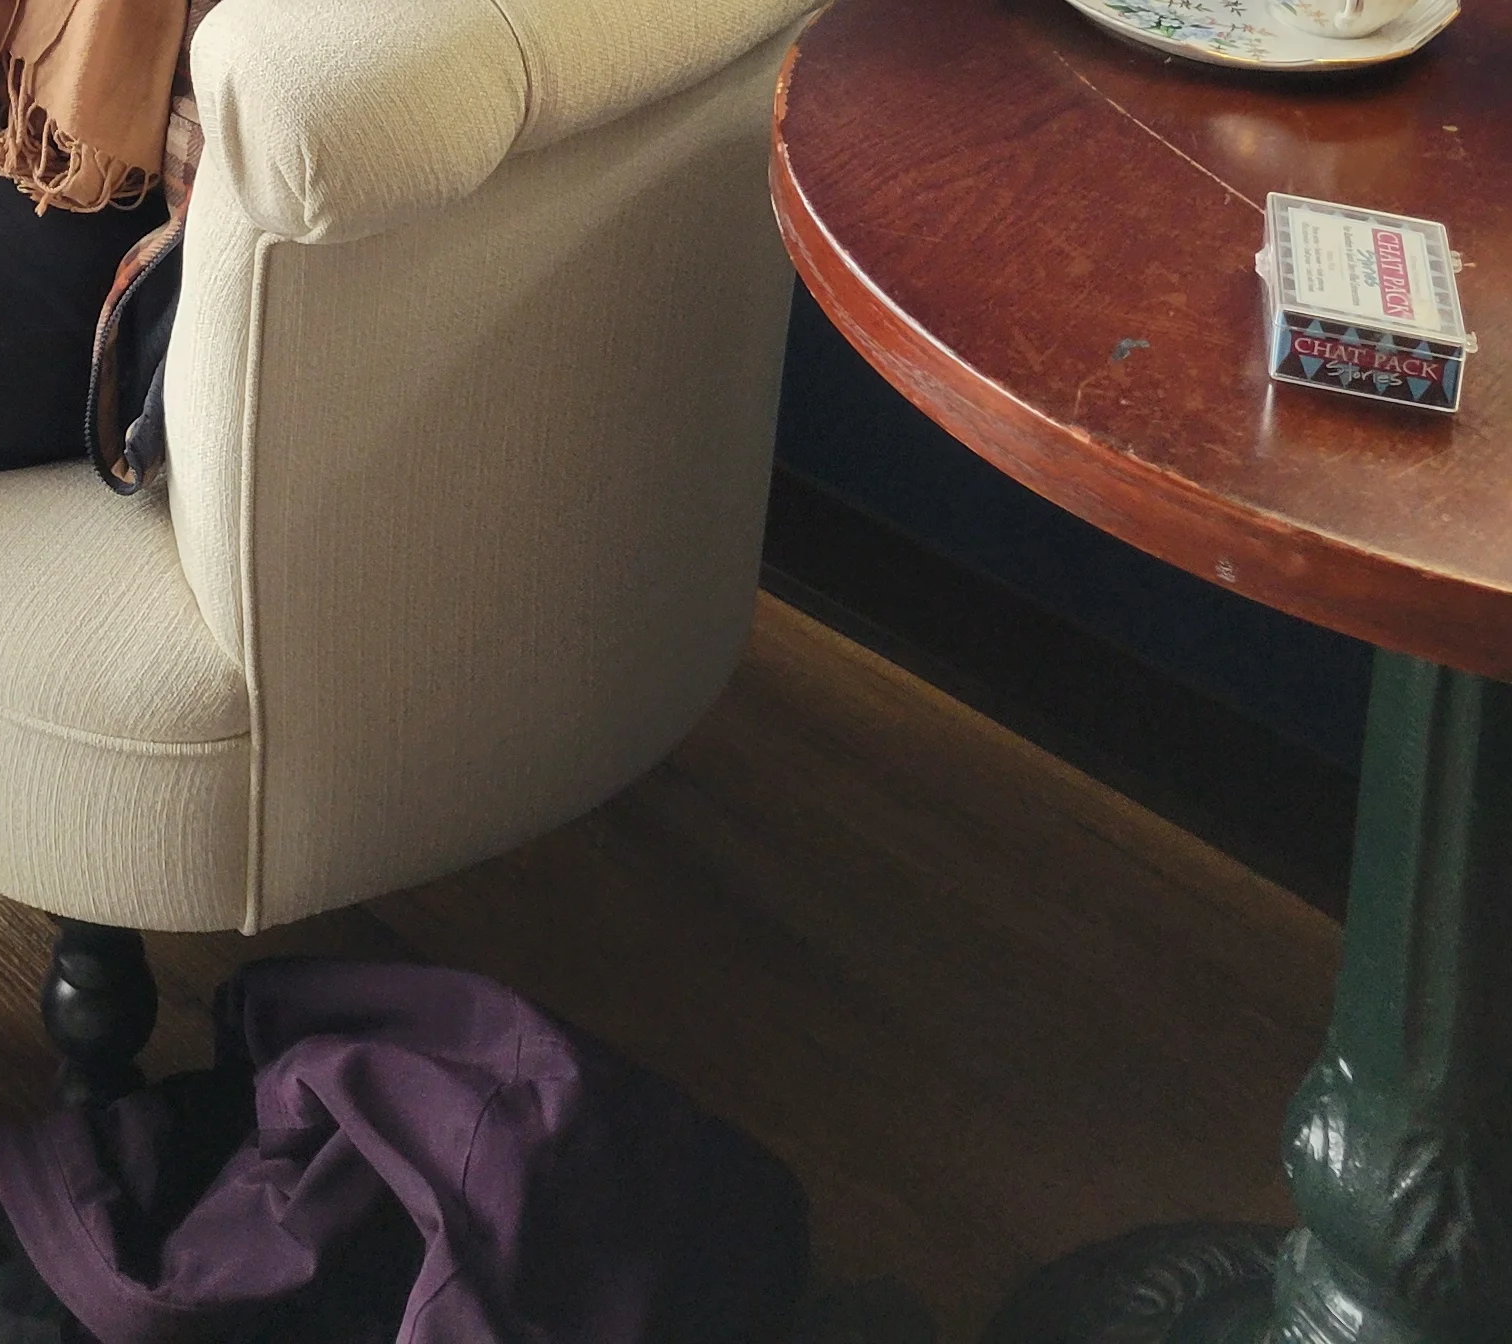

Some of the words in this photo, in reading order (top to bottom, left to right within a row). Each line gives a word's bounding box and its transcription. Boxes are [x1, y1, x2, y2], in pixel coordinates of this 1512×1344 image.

[1376, 231, 1404, 275] CHAT
[1383, 276, 1409, 317] PACK
[1294, 336, 1367, 363] CHAT
[1373, 352, 1439, 380] PACK
[1326, 360, 1403, 386] Stories
